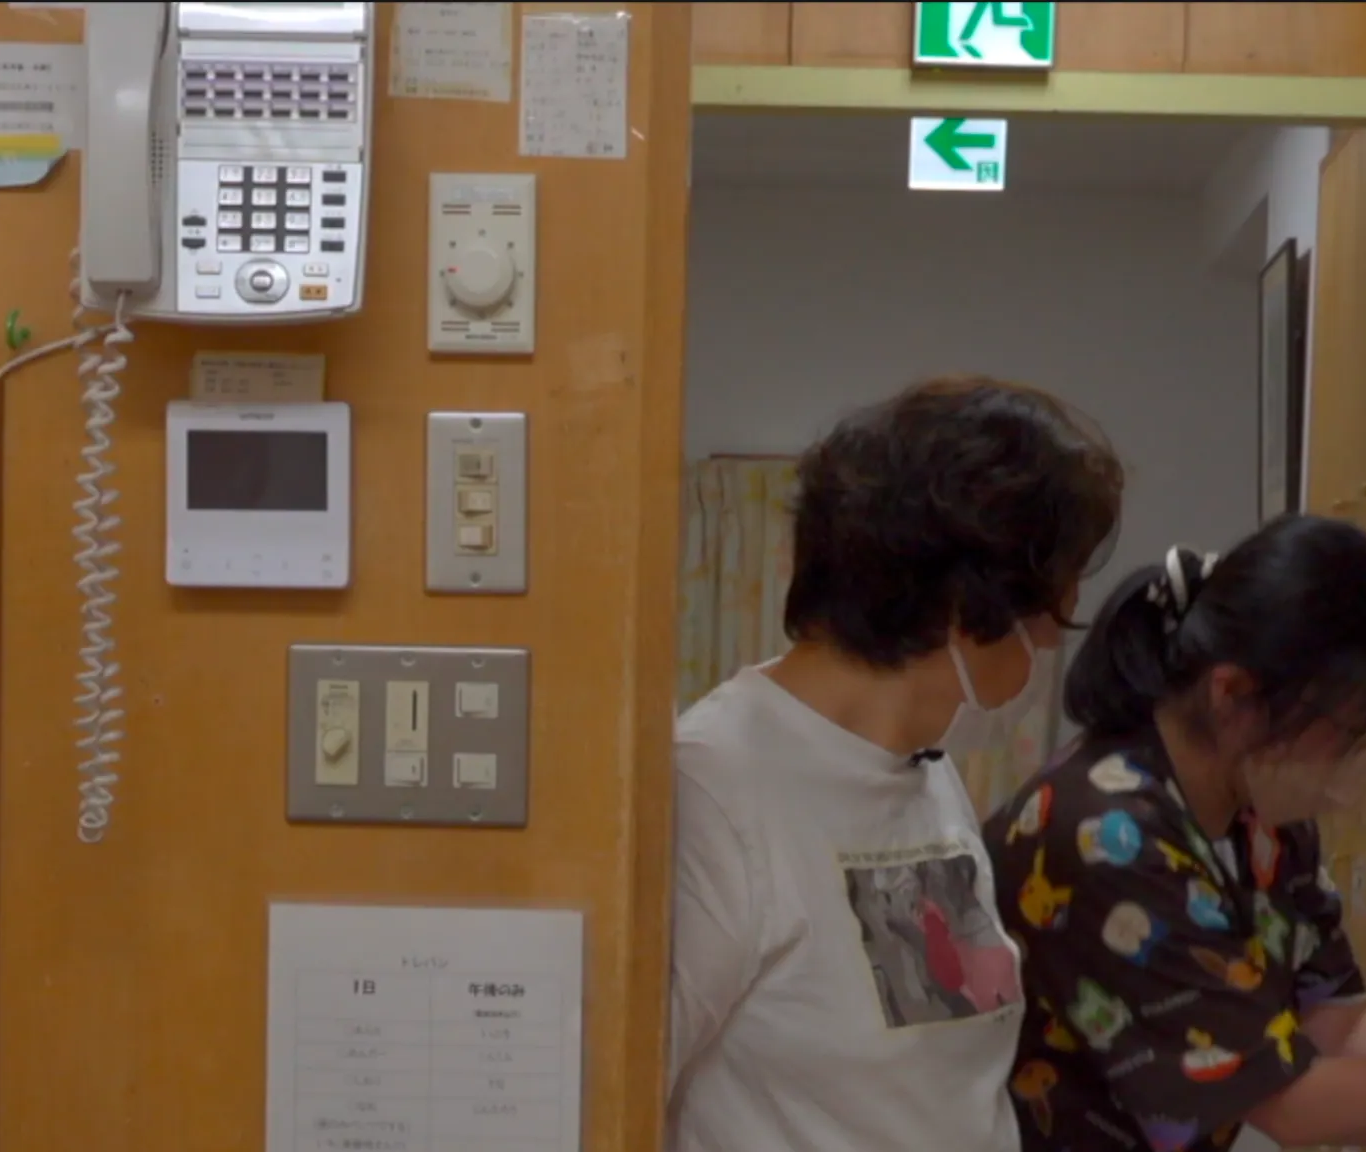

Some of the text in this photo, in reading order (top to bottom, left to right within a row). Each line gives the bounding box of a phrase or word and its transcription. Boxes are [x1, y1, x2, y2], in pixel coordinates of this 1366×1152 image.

[353, 979, 376, 995] 1日
[468, 982, 526, 998] 午後のみ
